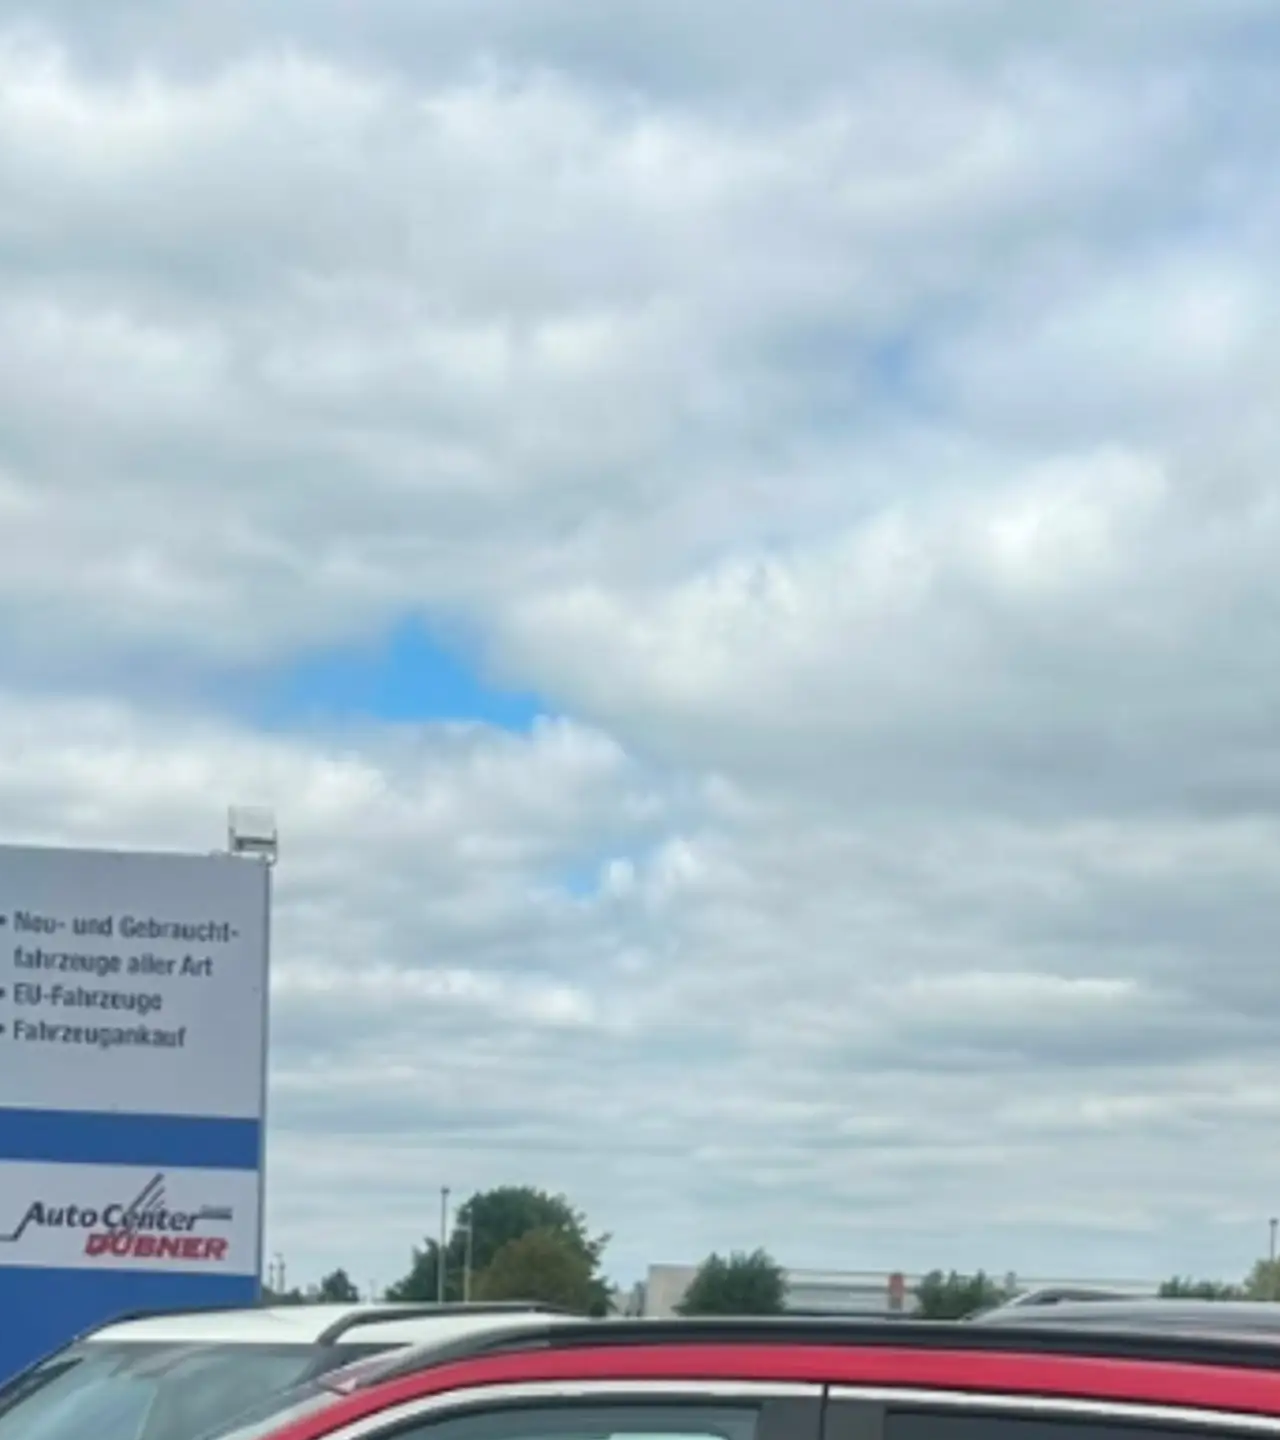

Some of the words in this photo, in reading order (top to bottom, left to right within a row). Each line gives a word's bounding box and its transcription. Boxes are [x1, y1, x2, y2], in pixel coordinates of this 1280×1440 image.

[13, 911, 66, 935] Neu-
[73, 916, 113, 937] und
[119, 916, 240, 943] Gebraucht-
[13, 946, 122, 977] fahrzeuge
[127, 954, 176, 976] aller
[179, 955, 214, 977] Art
[13, 983, 164, 1015] EU-Fahrzeuge
[13, 1020, 187, 1049] Fahrzeugankauf
[10, 1202, 98, 1236] Auto
[102, 1204, 200, 1232] Center
[84, 1230, 230, 1261] DÜBNER
